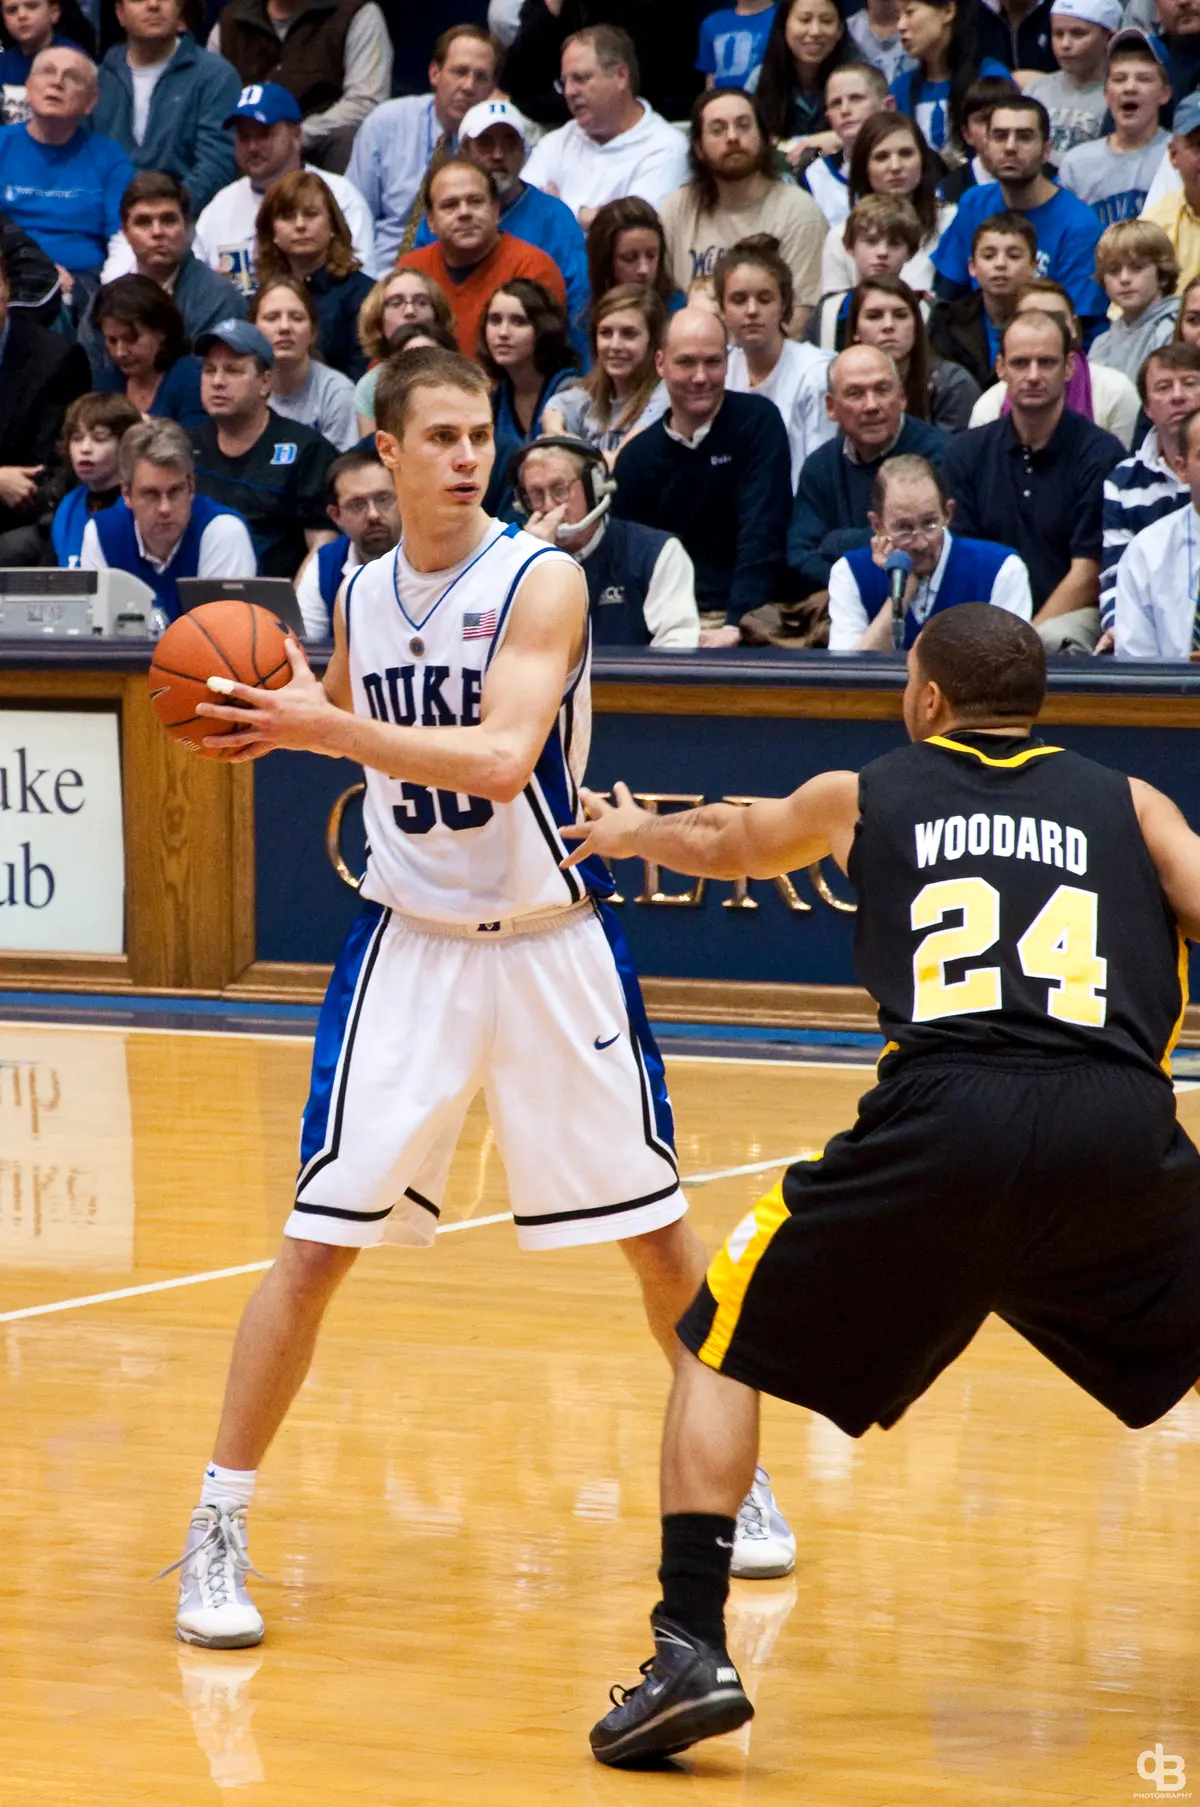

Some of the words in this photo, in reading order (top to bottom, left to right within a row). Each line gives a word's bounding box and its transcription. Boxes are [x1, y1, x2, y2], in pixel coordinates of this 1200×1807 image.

[362, 665, 482, 727] DUKE
[914, 813, 1088, 876] WOODARD
[910, 877, 1107, 1028] 24
